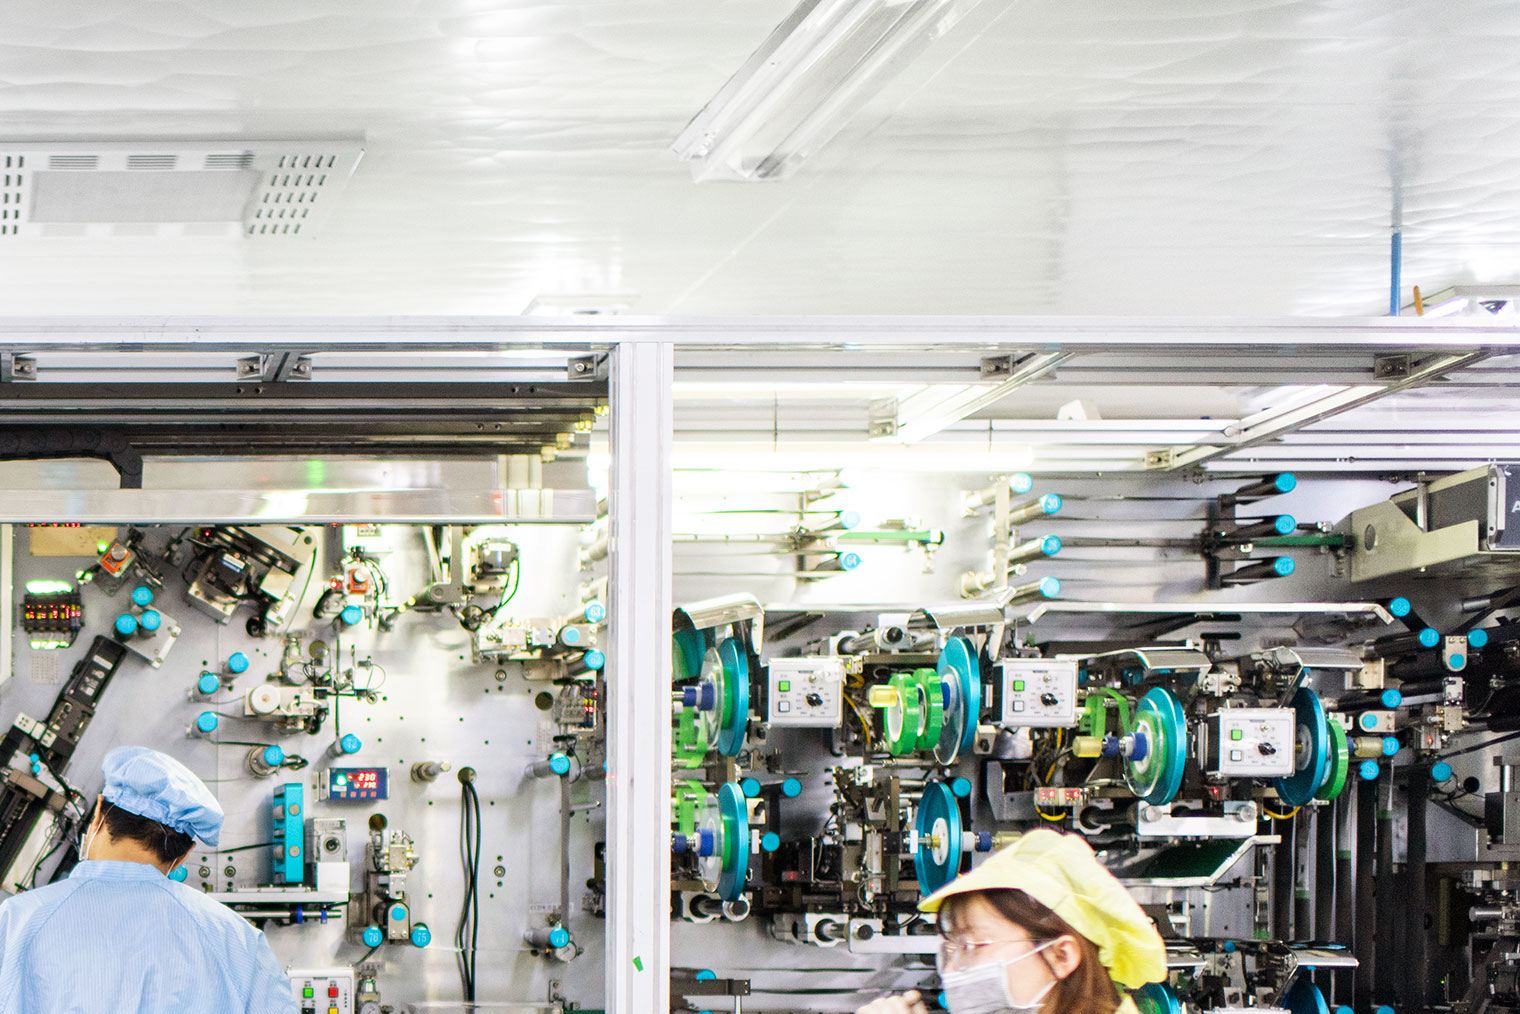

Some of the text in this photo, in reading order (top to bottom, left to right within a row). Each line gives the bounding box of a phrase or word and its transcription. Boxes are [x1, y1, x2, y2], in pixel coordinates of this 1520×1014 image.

[358, 773, 376, 781] 230
[368, 932, 379, 943] 76
[417, 932, 427, 943] 75
